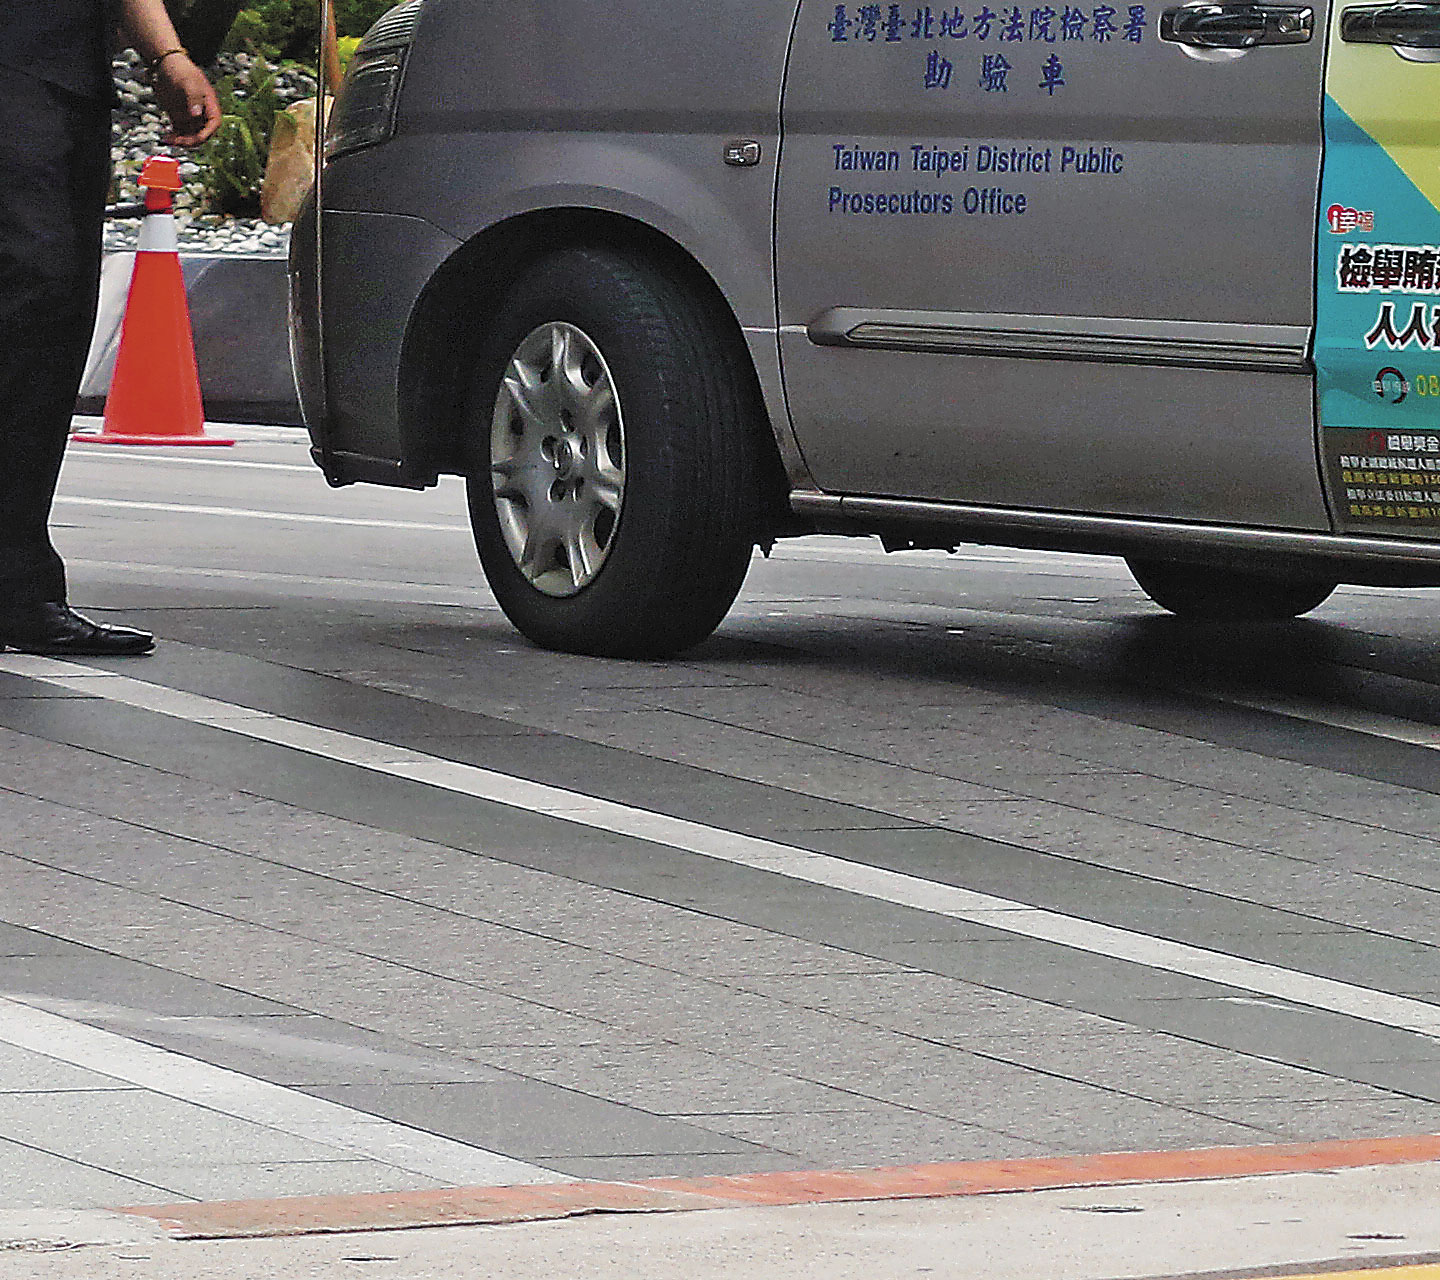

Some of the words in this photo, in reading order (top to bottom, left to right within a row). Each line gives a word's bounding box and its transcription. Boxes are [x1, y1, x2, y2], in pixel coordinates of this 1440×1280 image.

[828, 4, 1148, 43] 臺灣臺北地方法院檢察署
[833, 144, 900, 172] Taiwan
[910, 144, 969, 178] Taipei
[976, 145, 1052, 173] District
[1061, 146, 1124, 174] Public
[828, 186, 954, 214] Prosecutors
[963, 187, 1028, 215] Office
